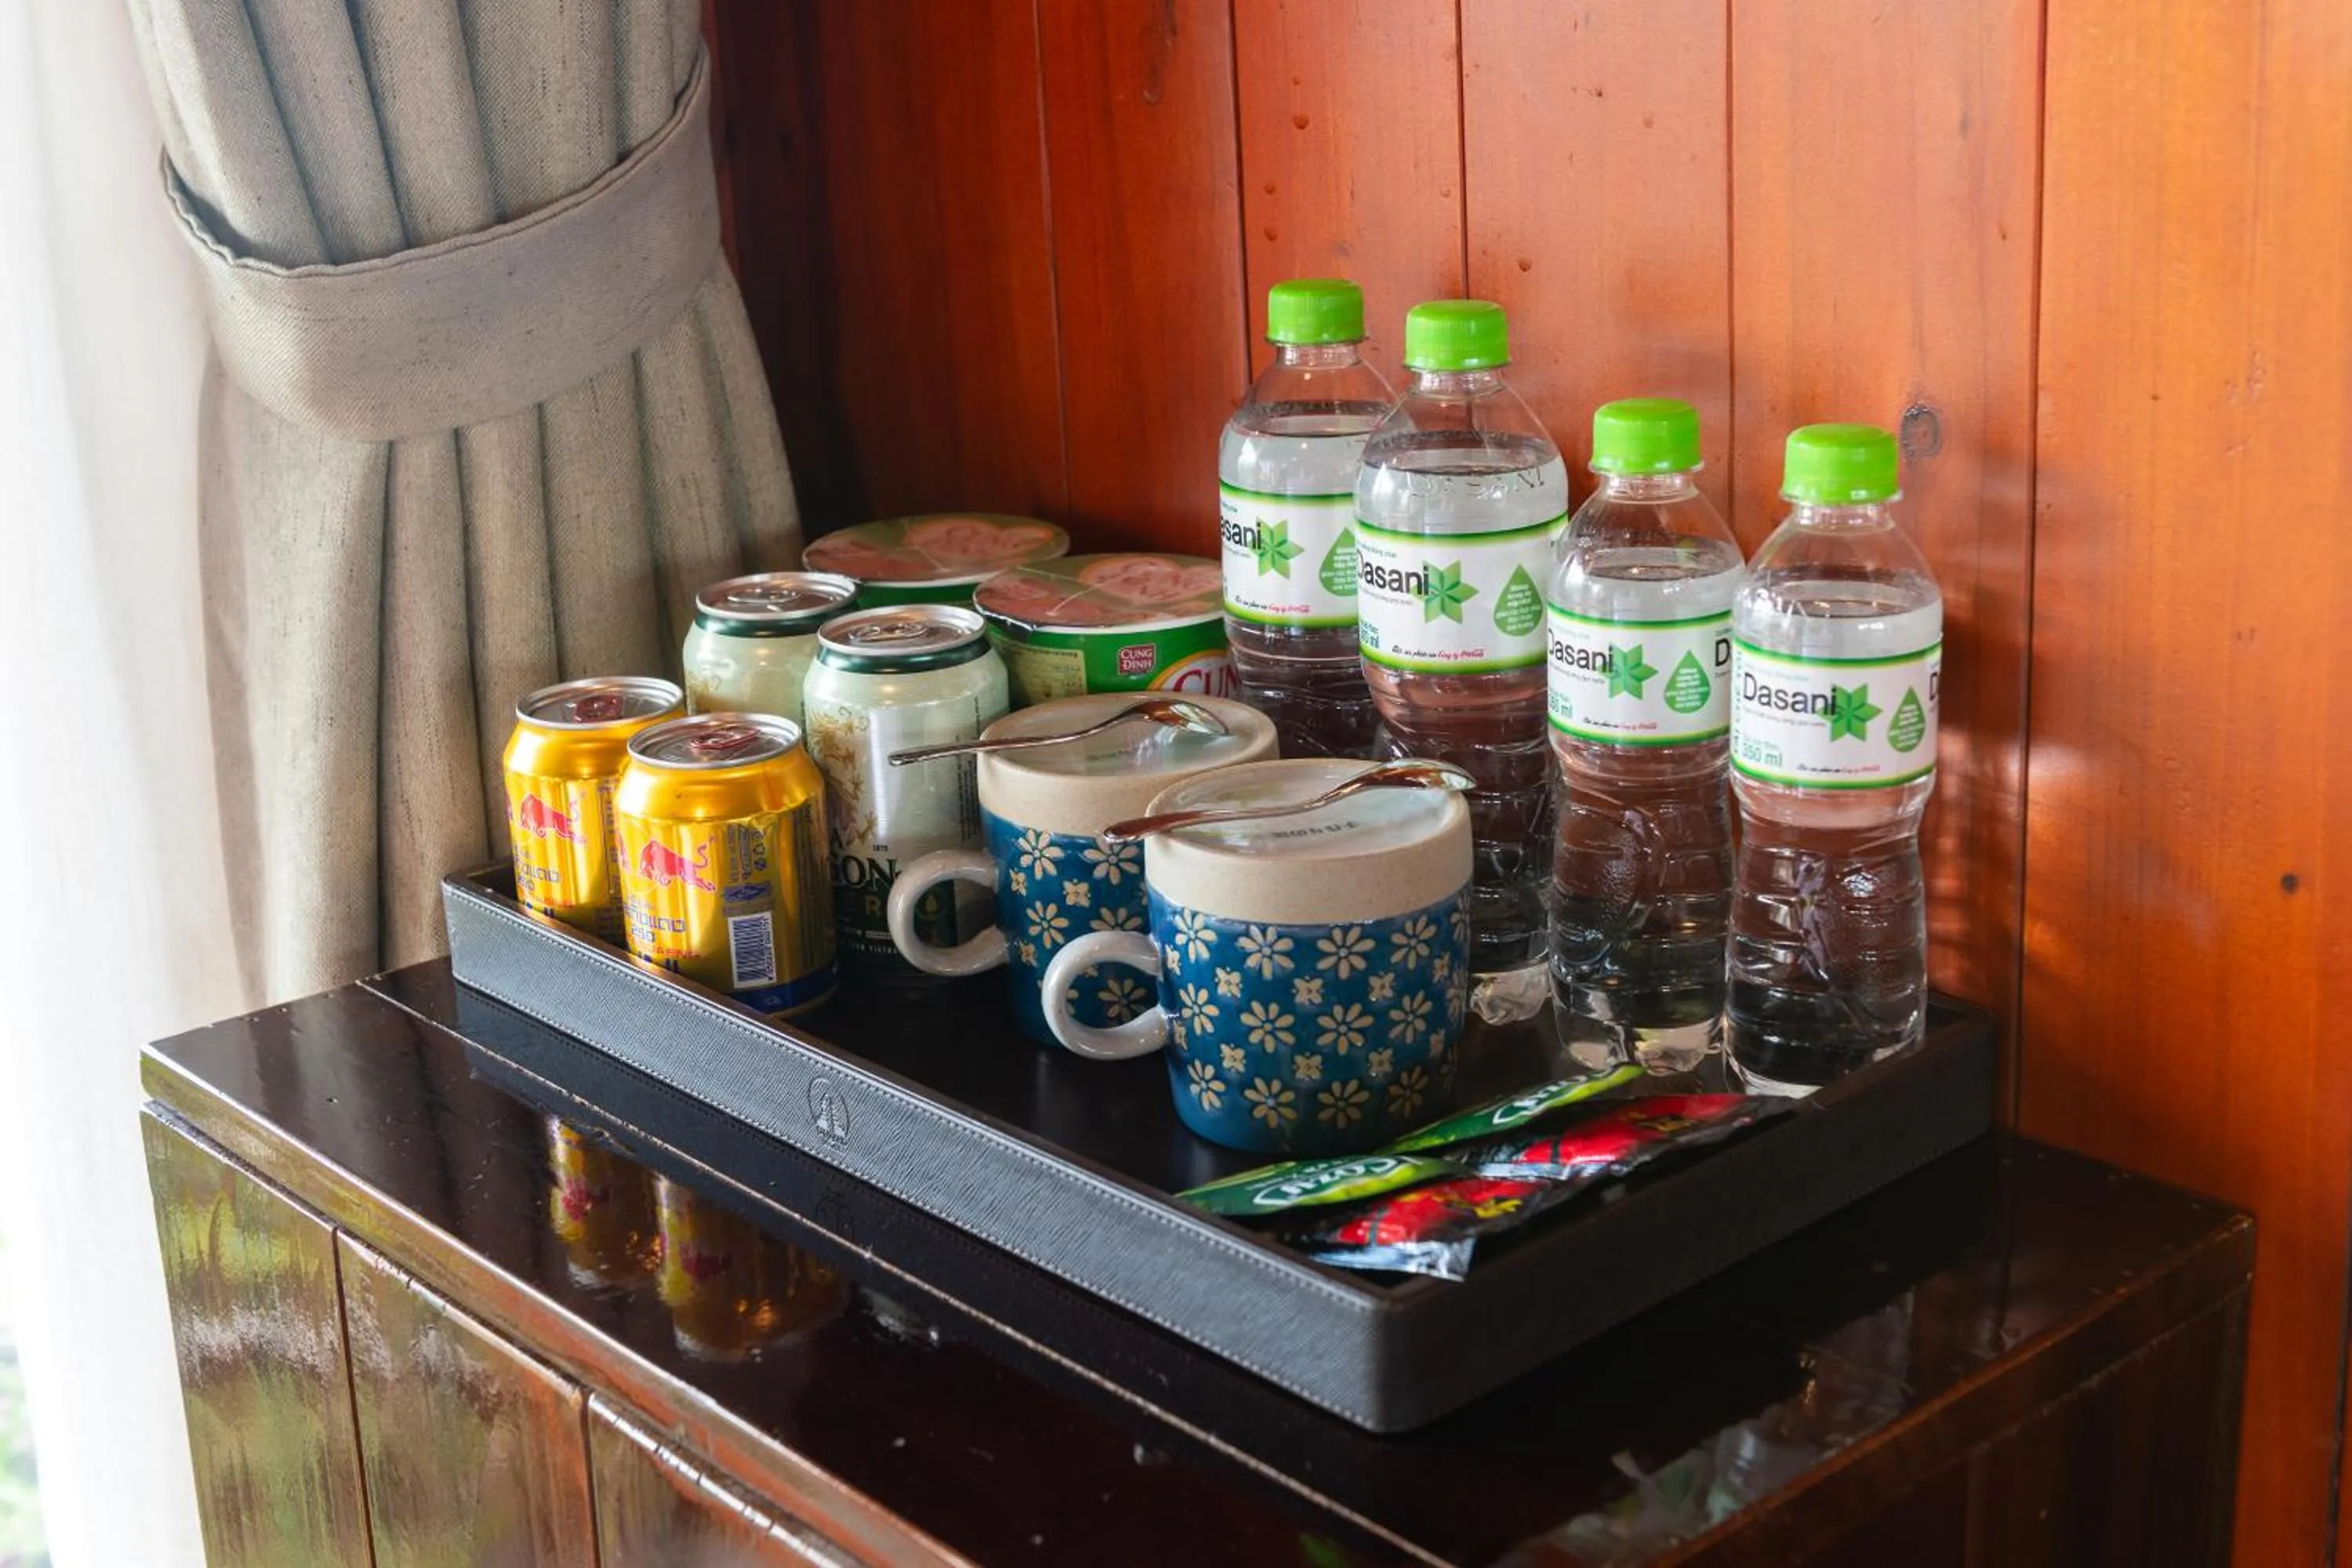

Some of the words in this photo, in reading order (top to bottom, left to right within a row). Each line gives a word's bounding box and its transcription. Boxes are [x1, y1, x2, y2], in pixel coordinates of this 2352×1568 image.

[1120, 648, 1152, 659] CUNG
[1743, 672, 1838, 716] Dasani
[1765, 752, 1783, 768] ml
